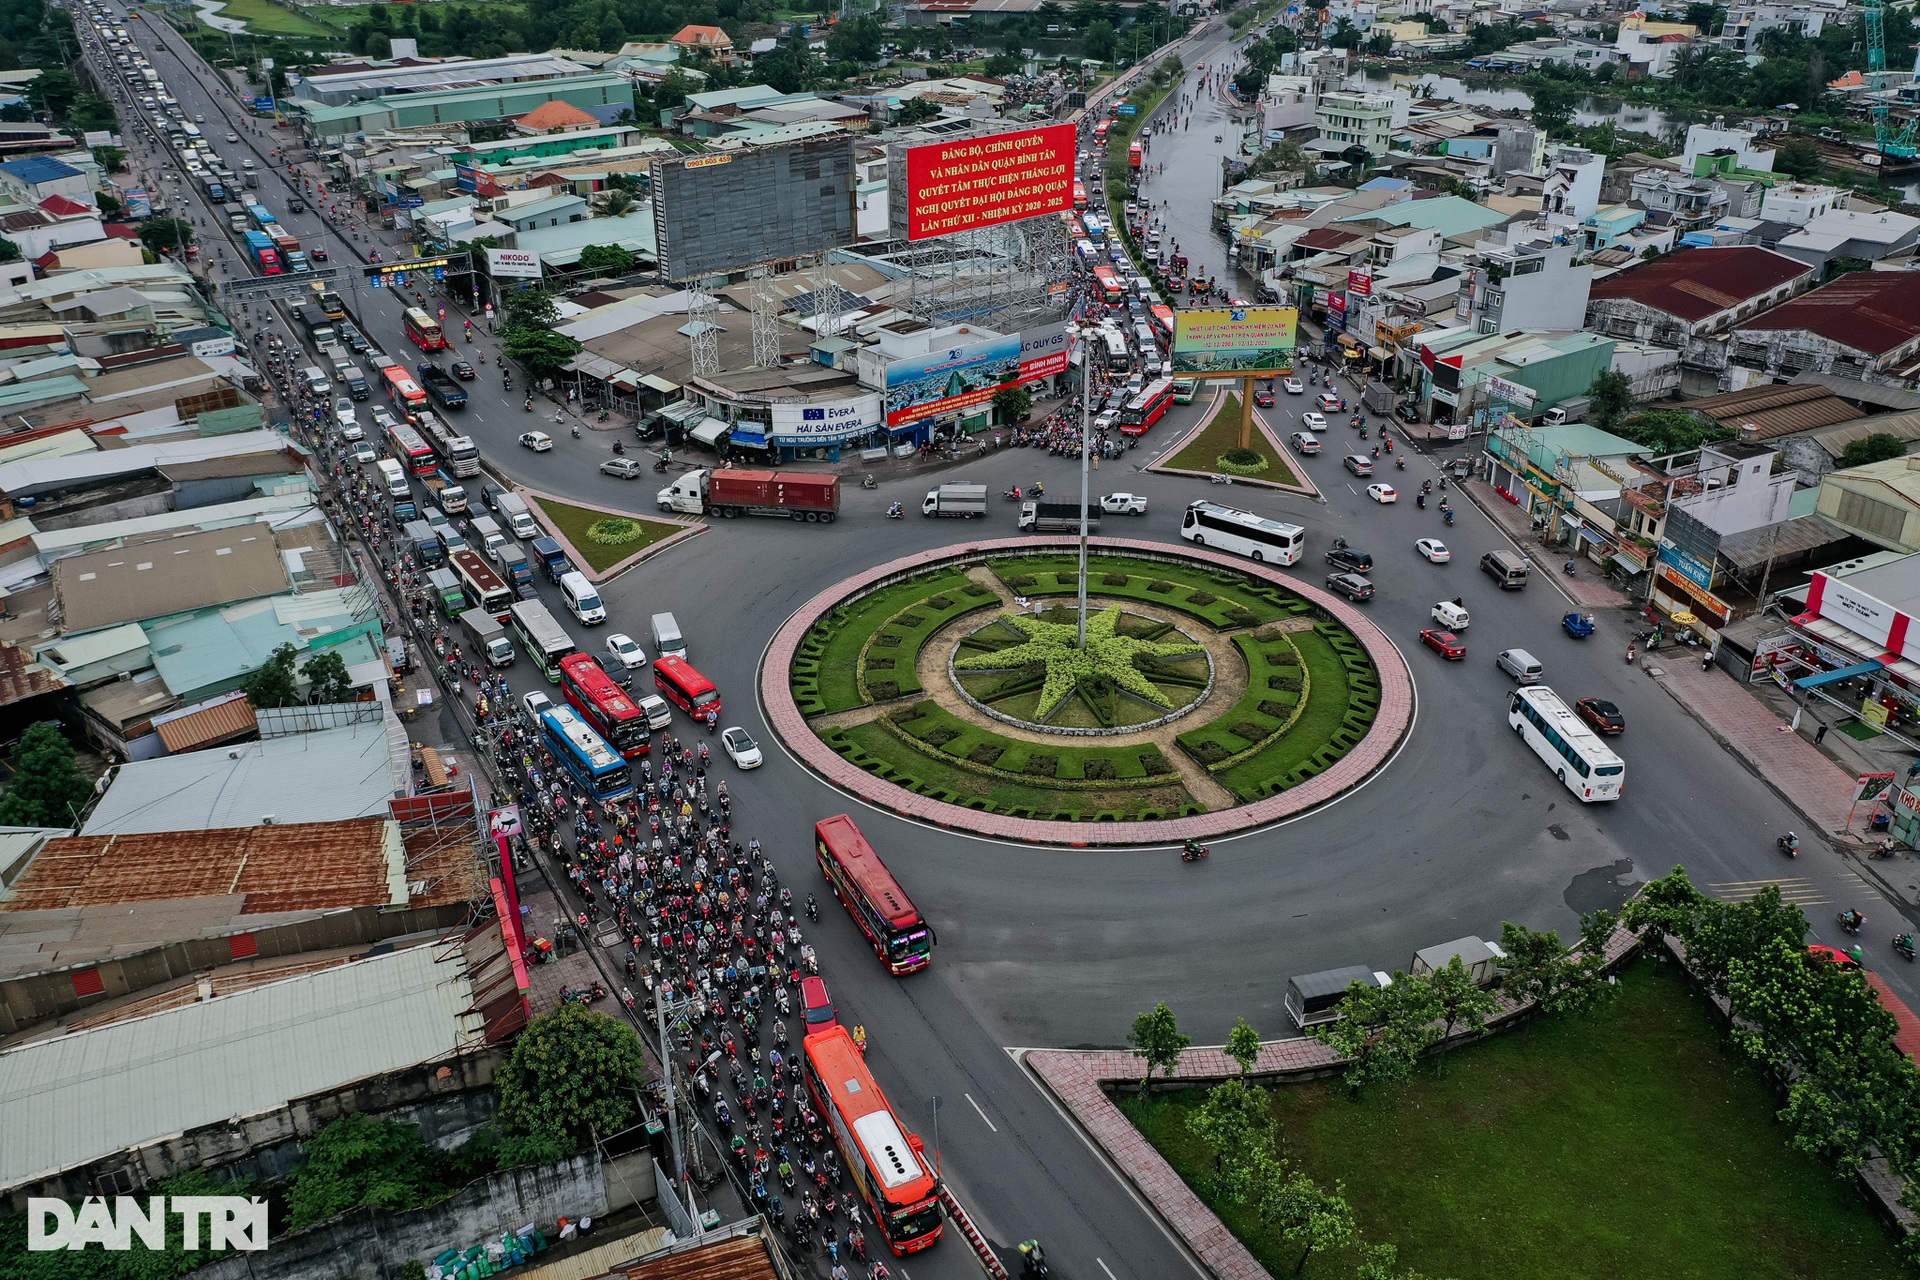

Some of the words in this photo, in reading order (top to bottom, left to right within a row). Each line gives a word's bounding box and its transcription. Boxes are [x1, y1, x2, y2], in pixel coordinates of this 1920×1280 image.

[942, 146, 966, 160] ĐẢNG
[986, 140, 1012, 153] CHÍNH
[1015, 135, 1044, 148] QUYỀN
[930, 166, 942, 179] VÀ
[945, 164, 970, 178] NHÂN
[972, 160, 990, 172] DÂN
[992, 157, 1016, 170] QUẬN
[1018, 152, 1037, 164] BÌNH
[1039, 149, 1056, 160] TÂN
[918, 184, 948, 200] QUYẾT
[951, 180, 970, 194] TÂM
[972, 176, 997, 190] THỰC
[999, 174, 1020, 186] HIỆN
[1052, 164, 1066, 176] LỢI
[916, 204, 940, 216] NGHỊ
[941, 198, 970, 212] QUYẾT
[973, 196, 988, 206] ĐẠI
[990, 192, 1006, 204] HỘI
[1008, 187, 1030, 199] ĐẢNG
[1032, 185, 1044, 196] BỘ
[1046, 180, 1068, 193] QUẬN
[921, 218, 939, 232] LẦN
[942, 214, 961, 228] THỨ
[962, 213, 975, 224] XII
[982, 208, 1010, 221] NHIỆM
[1025, 200, 1041, 212] 2020
[1048, 196, 1063, 208] 2025
[1033, 338, 1049, 349] QUY
[1051, 334, 1063, 344] GS
[1030, 360, 1045, 370] BÌNH
[1047, 355, 1064, 366] MINH
[835, 419, 862, 431] EVERA
[1900, 791, 1915, 808] KHO
